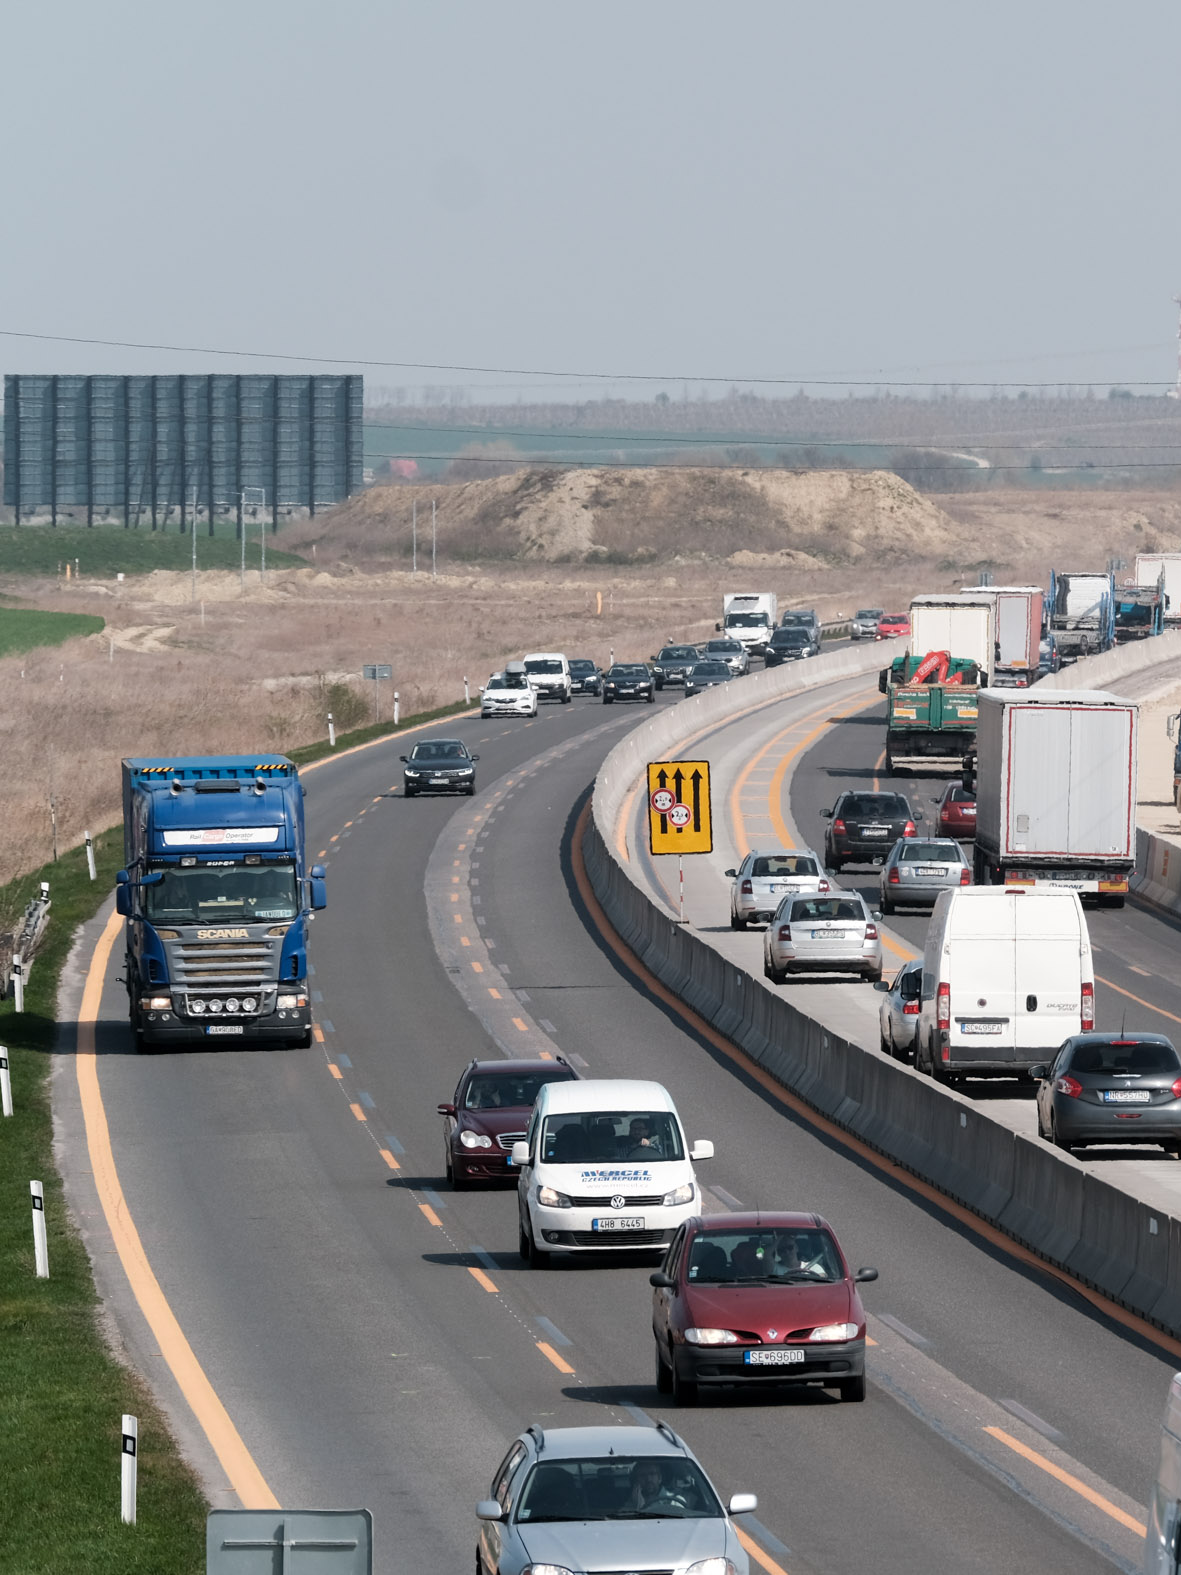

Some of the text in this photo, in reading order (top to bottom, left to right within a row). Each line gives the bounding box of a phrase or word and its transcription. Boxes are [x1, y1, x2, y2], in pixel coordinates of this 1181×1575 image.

[225, 832, 254, 840] Operator
[197, 929, 249, 939] SCANIA
[600, 1219, 641, 1229] 4H8 6445
